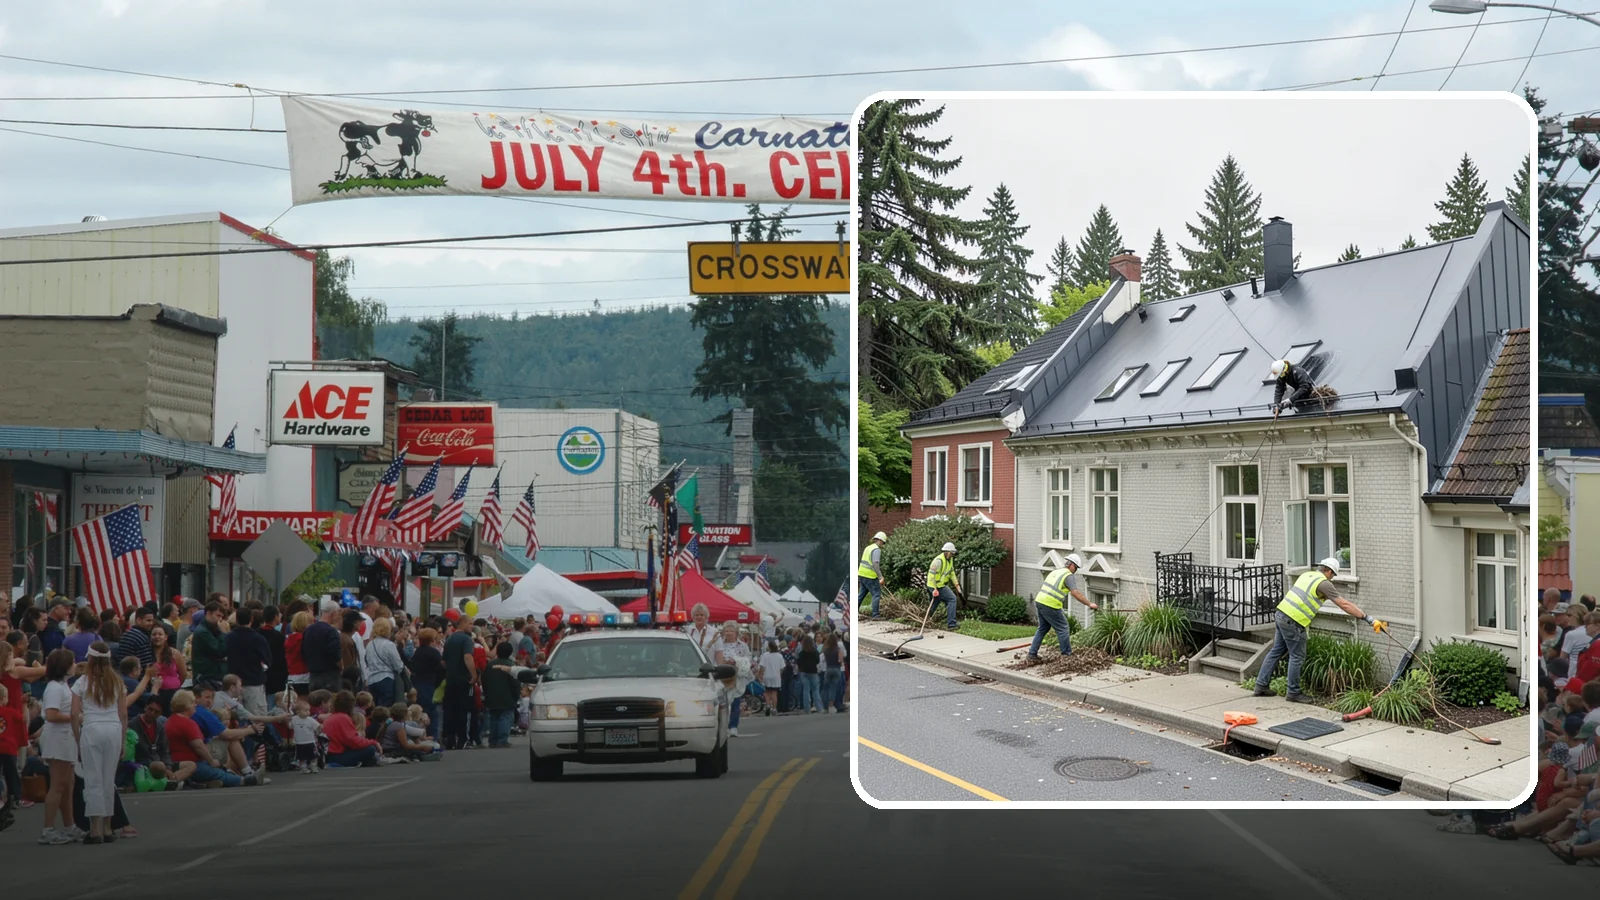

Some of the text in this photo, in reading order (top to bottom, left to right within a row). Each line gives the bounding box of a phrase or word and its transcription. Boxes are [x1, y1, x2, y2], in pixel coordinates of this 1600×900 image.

[694, 121, 850, 149] Carnat
[481, 141, 605, 192] JULY
[632, 150, 746, 198] 4th.
[697, 254, 850, 280] CROSSWA
[283, 380, 373, 420] ACE
[406, 409, 452, 421] CEDAR
[284, 421, 371, 437] Hardware
[416, 428, 477, 446] Coca-Cola
[96, 485, 124, 495] Vincent
[126, 486, 136, 495] de
[138, 486, 155, 496] Paul
[688, 526, 741, 535] CRNATION
[699, 535, 730, 544] GLASS
